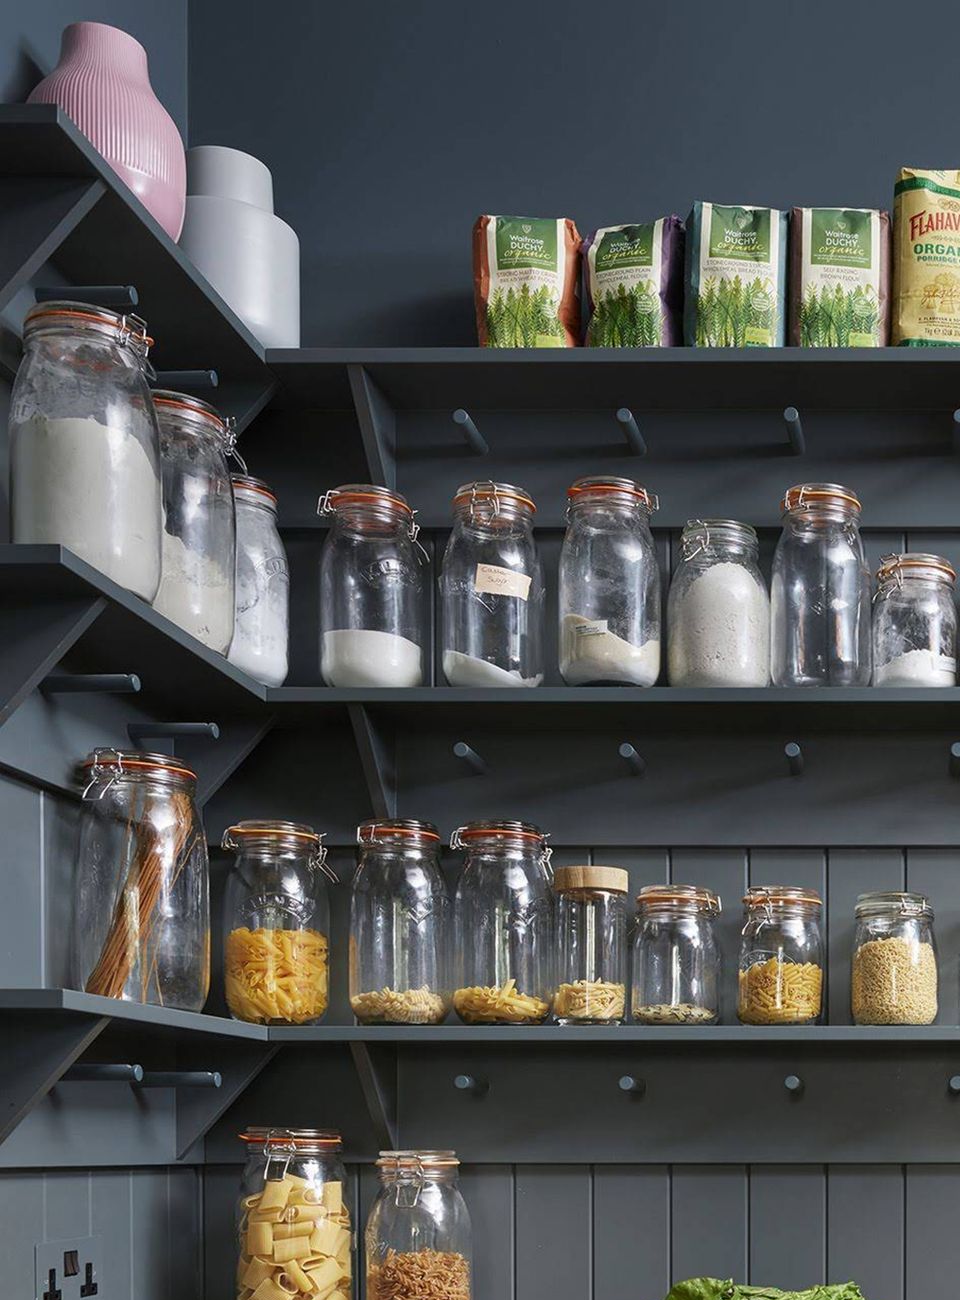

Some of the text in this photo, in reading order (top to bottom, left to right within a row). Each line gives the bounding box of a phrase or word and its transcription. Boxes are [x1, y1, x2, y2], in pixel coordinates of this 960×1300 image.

[509, 234, 544, 246] Waitrose
[825, 230, 859, 240] Waitrose
[724, 236, 757, 246] DUCHY
[825, 238, 859, 248] DUCHY
[510, 241, 543, 252] DUCHY
